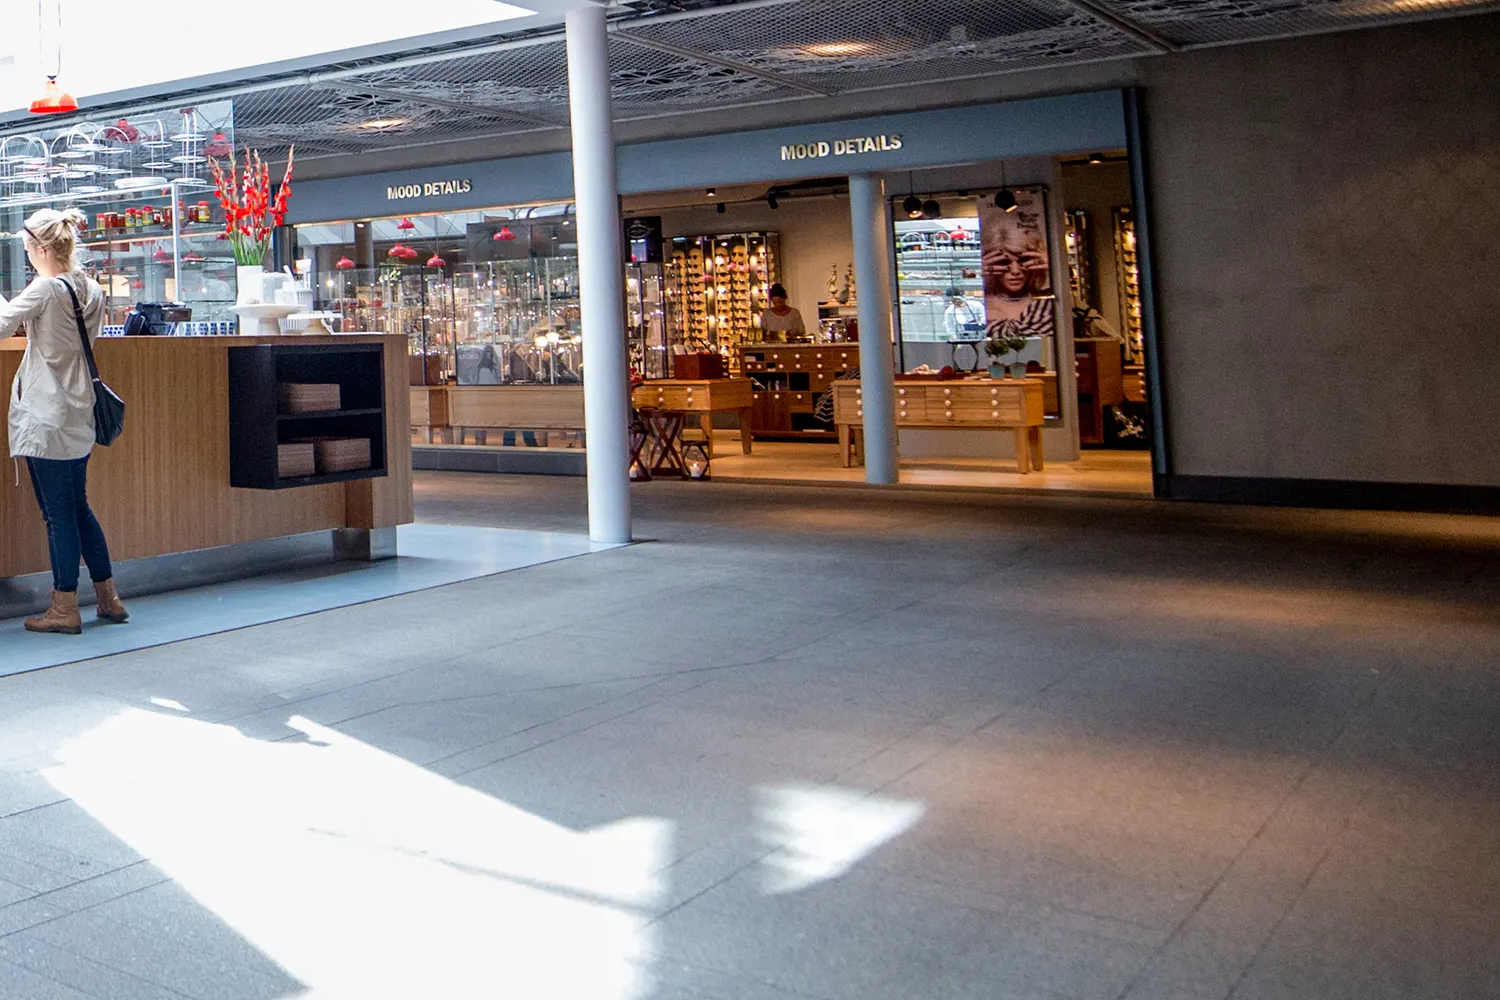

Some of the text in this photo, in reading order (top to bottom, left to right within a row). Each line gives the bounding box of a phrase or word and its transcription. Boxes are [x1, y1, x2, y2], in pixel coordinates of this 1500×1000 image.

[781, 134, 903, 161] MOOD DETAILS
[387, 179, 471, 200] MOOD DETAILS
